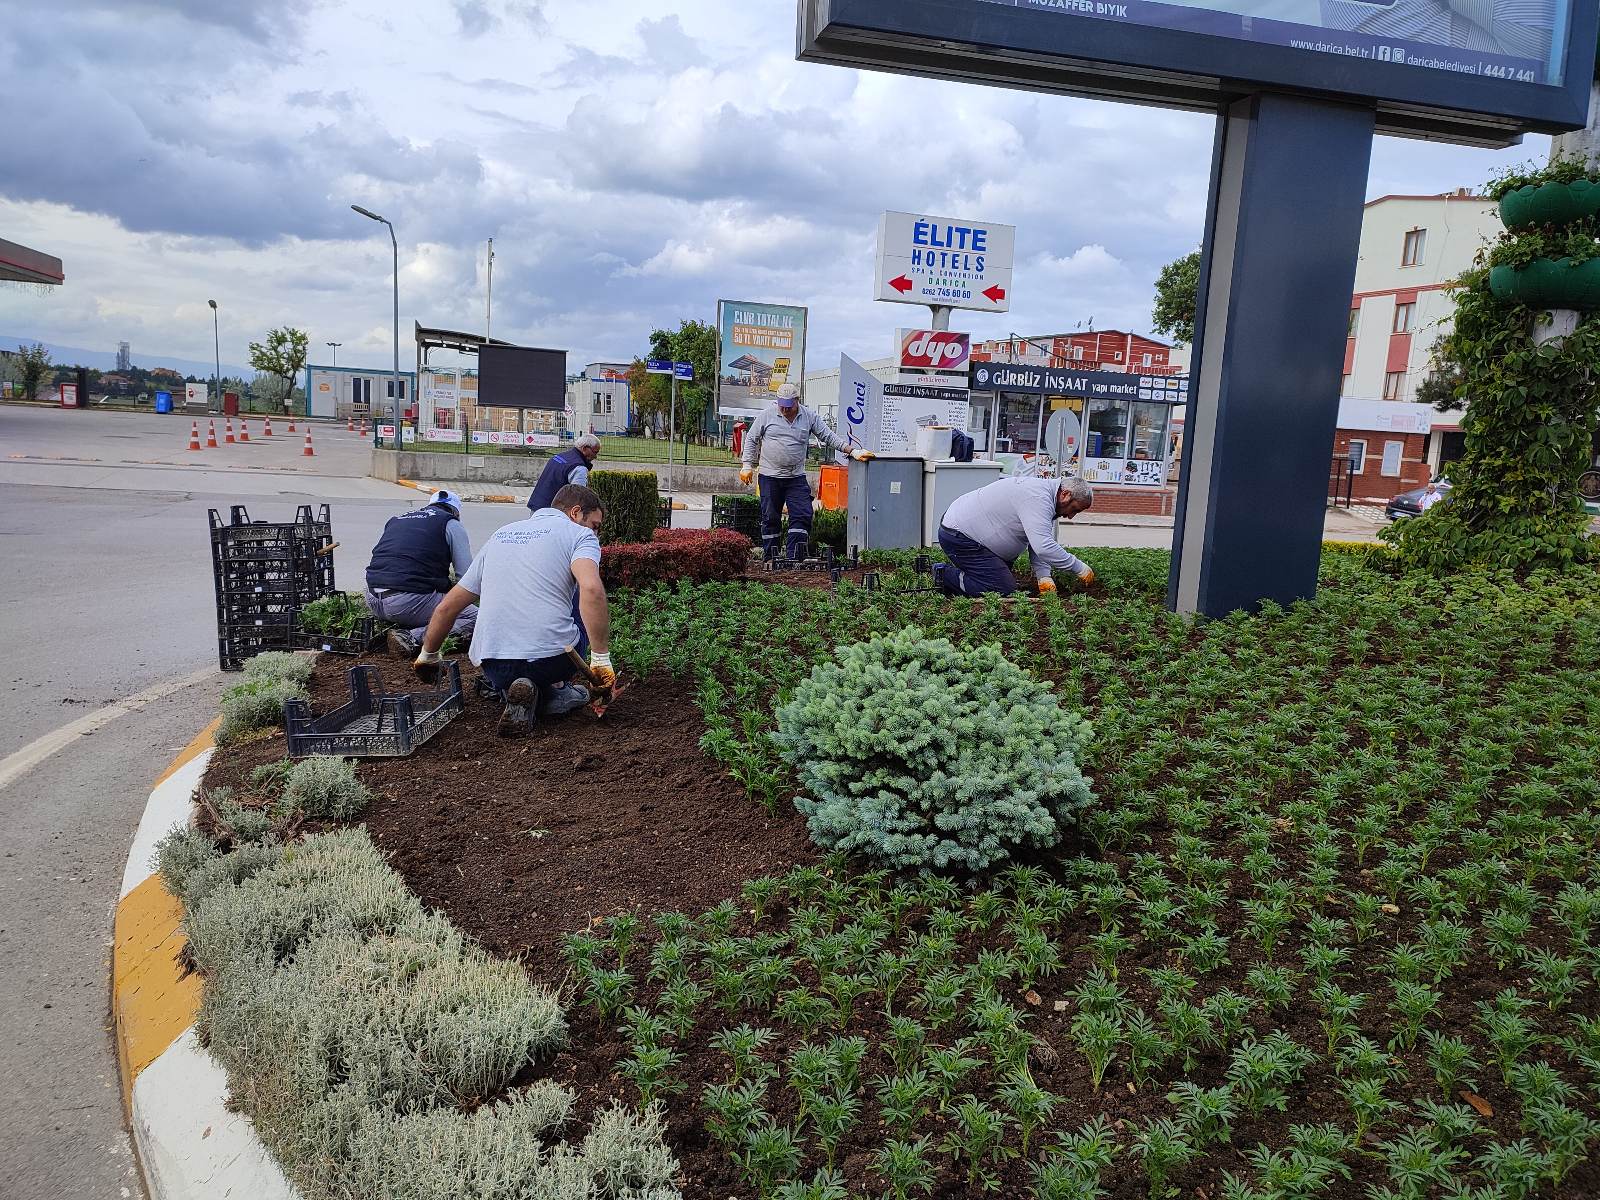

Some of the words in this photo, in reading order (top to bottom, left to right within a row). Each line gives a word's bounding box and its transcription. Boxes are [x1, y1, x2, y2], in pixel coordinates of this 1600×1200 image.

[1096, 3, 1127, 18] BIYIK
[1290, 40, 1368, 58] www.darica.bel.tr
[1484, 64, 1505, 78] 444
[1508, 67, 1514, 79] 7
[1516, 69, 1534, 82] 441
[913, 218, 987, 251] ÉLITE
[911, 249, 985, 272] HOTELS
[911, 267, 925, 275] SPA
[937, 287, 951, 297] 745
[962, 290, 971, 299] 60
[734, 310, 755, 325] CLUB
[757, 312, 780, 328] TOTAL
[908, 332, 963, 366] dyo
[992, 369, 1041, 388] GÜRBÜZ
[1044, 371, 1089, 393] İNŞAAT
[1091, 382, 1108, 394] yapı
[1109, 383, 1138, 395] market
